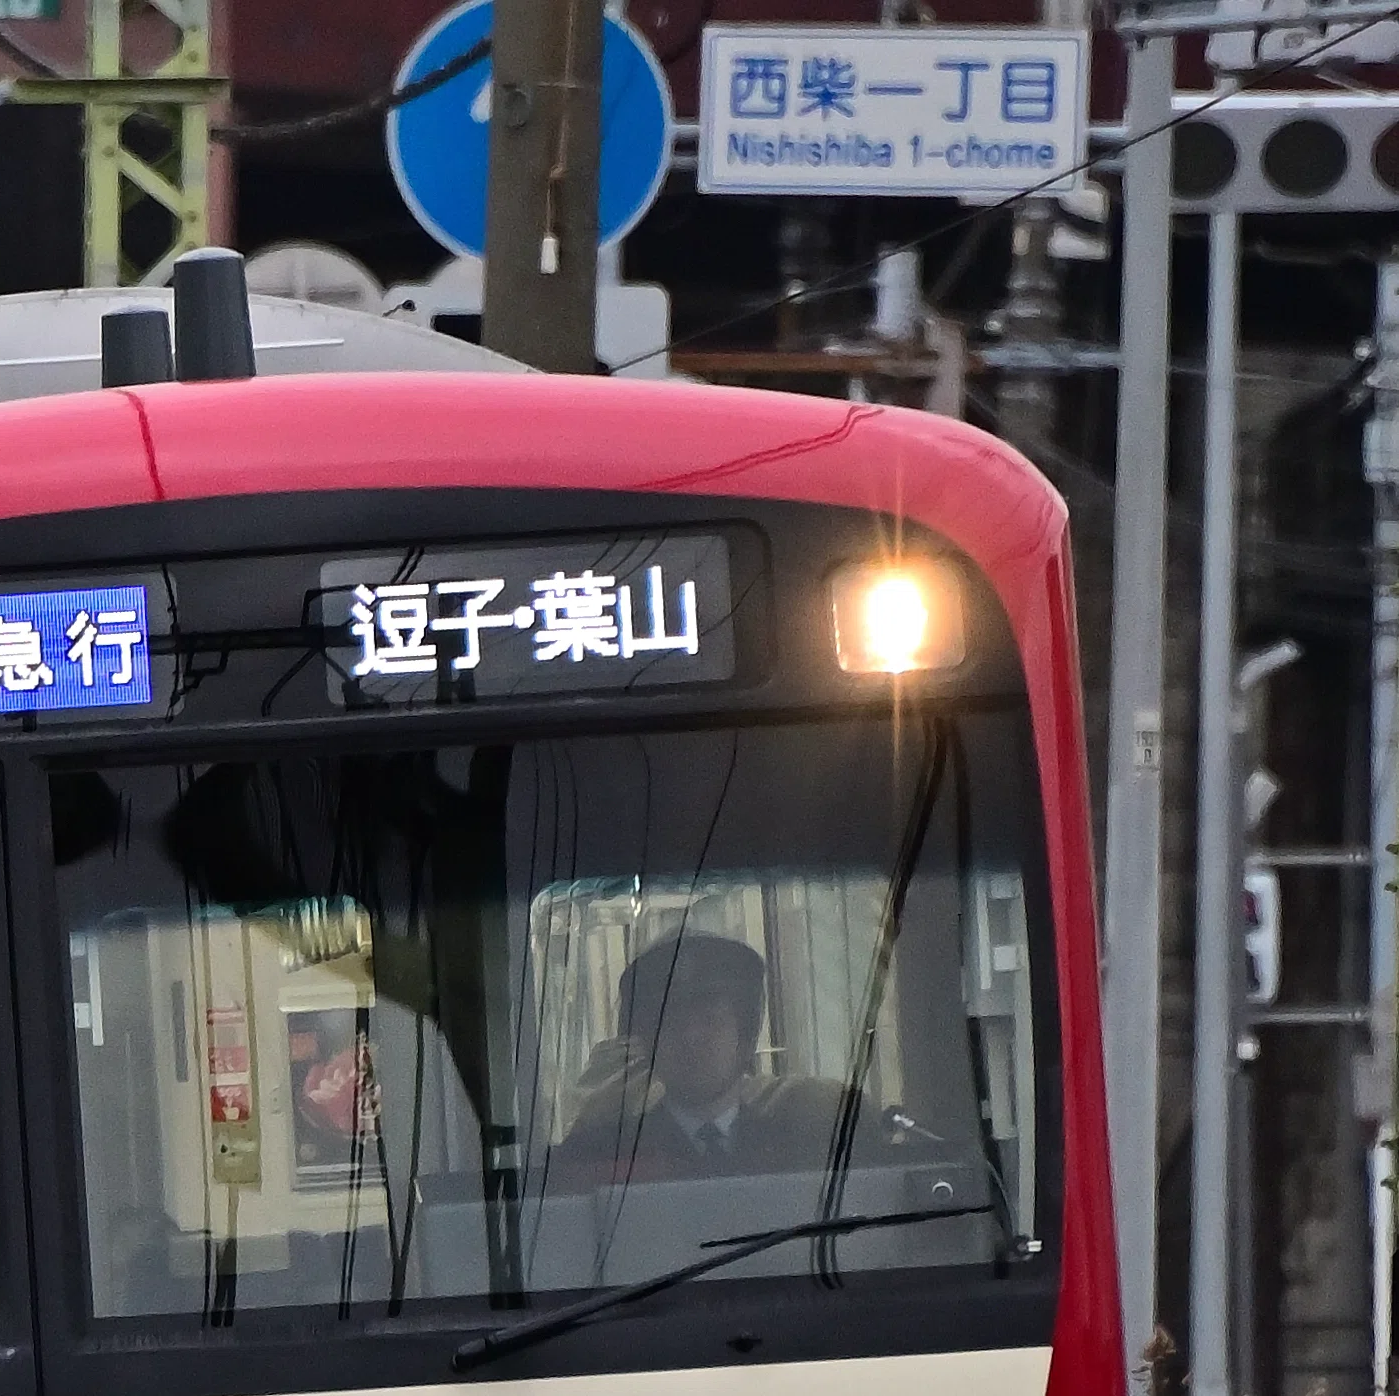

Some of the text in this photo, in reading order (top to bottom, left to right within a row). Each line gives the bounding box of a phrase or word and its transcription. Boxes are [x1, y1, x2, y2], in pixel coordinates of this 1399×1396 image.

[730, 58, 1055, 122] 西柴一丁目
[727, 133, 1056, 168] Nishishiba 1-chome
